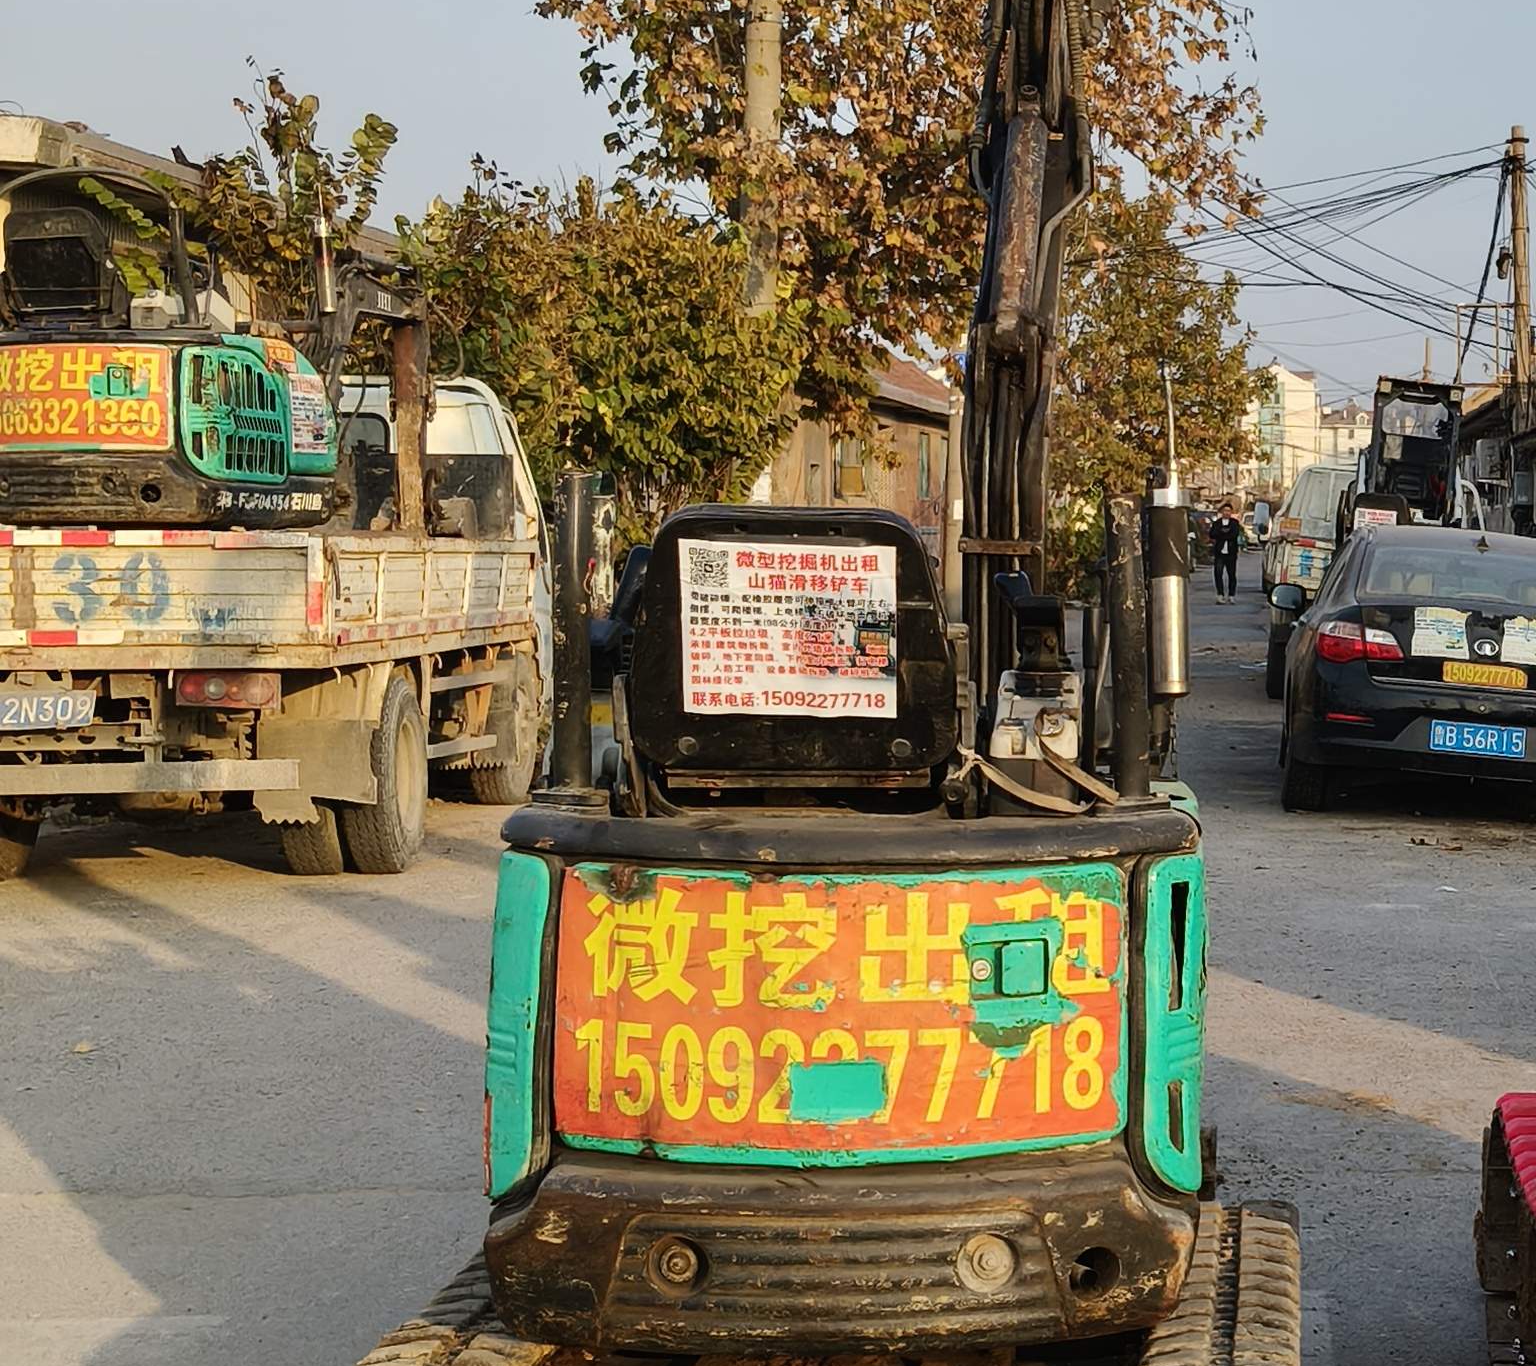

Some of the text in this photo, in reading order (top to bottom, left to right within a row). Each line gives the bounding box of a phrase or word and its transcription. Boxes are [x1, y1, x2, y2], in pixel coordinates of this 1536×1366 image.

[735, 551, 880, 572] 微型挖掘机出租
[748, 573, 869, 594] 山猫滑移铲车
[1446, 664, 1525, 686] 15092277718
